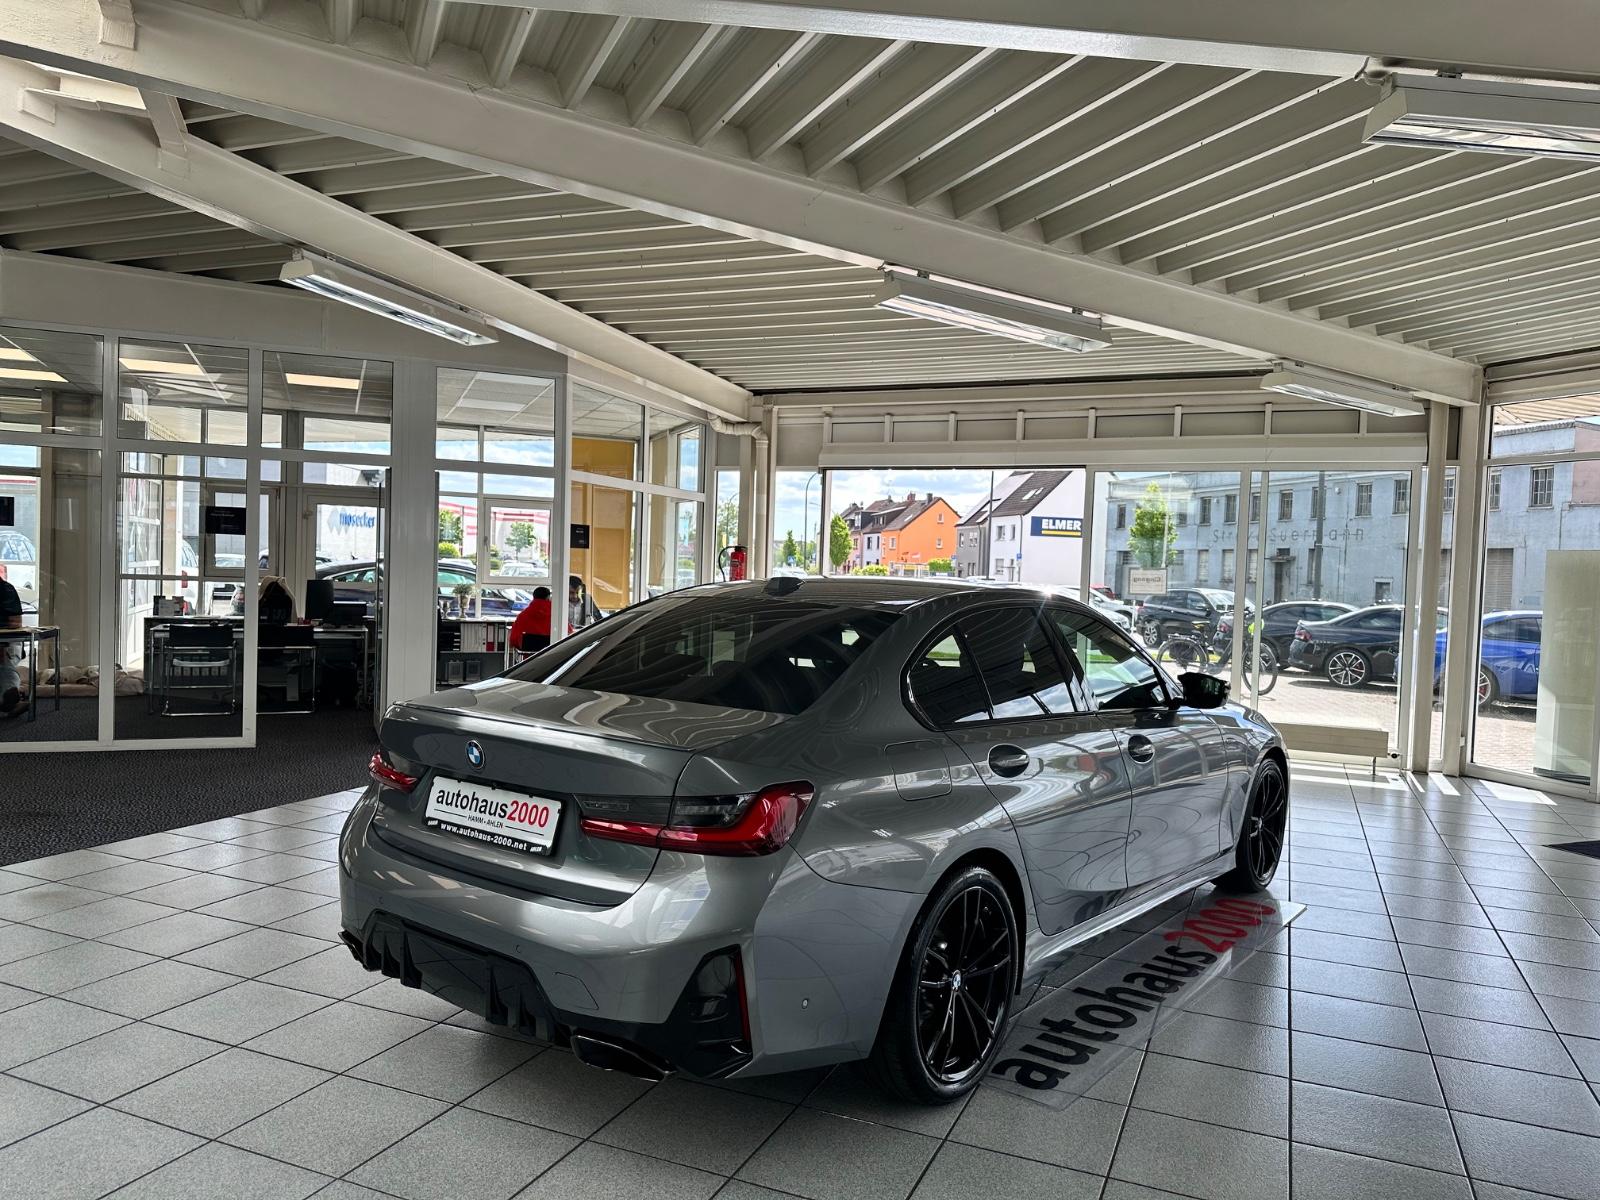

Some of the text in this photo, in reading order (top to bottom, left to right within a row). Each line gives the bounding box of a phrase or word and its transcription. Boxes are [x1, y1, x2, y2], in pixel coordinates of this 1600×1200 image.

[1041, 518, 1082, 530] ELMER
[436, 788, 550, 828] autohaus2000
[440, 823, 527, 851] www.autohaus-2000.net
[991, 898, 1277, 1091] autohaus2000
